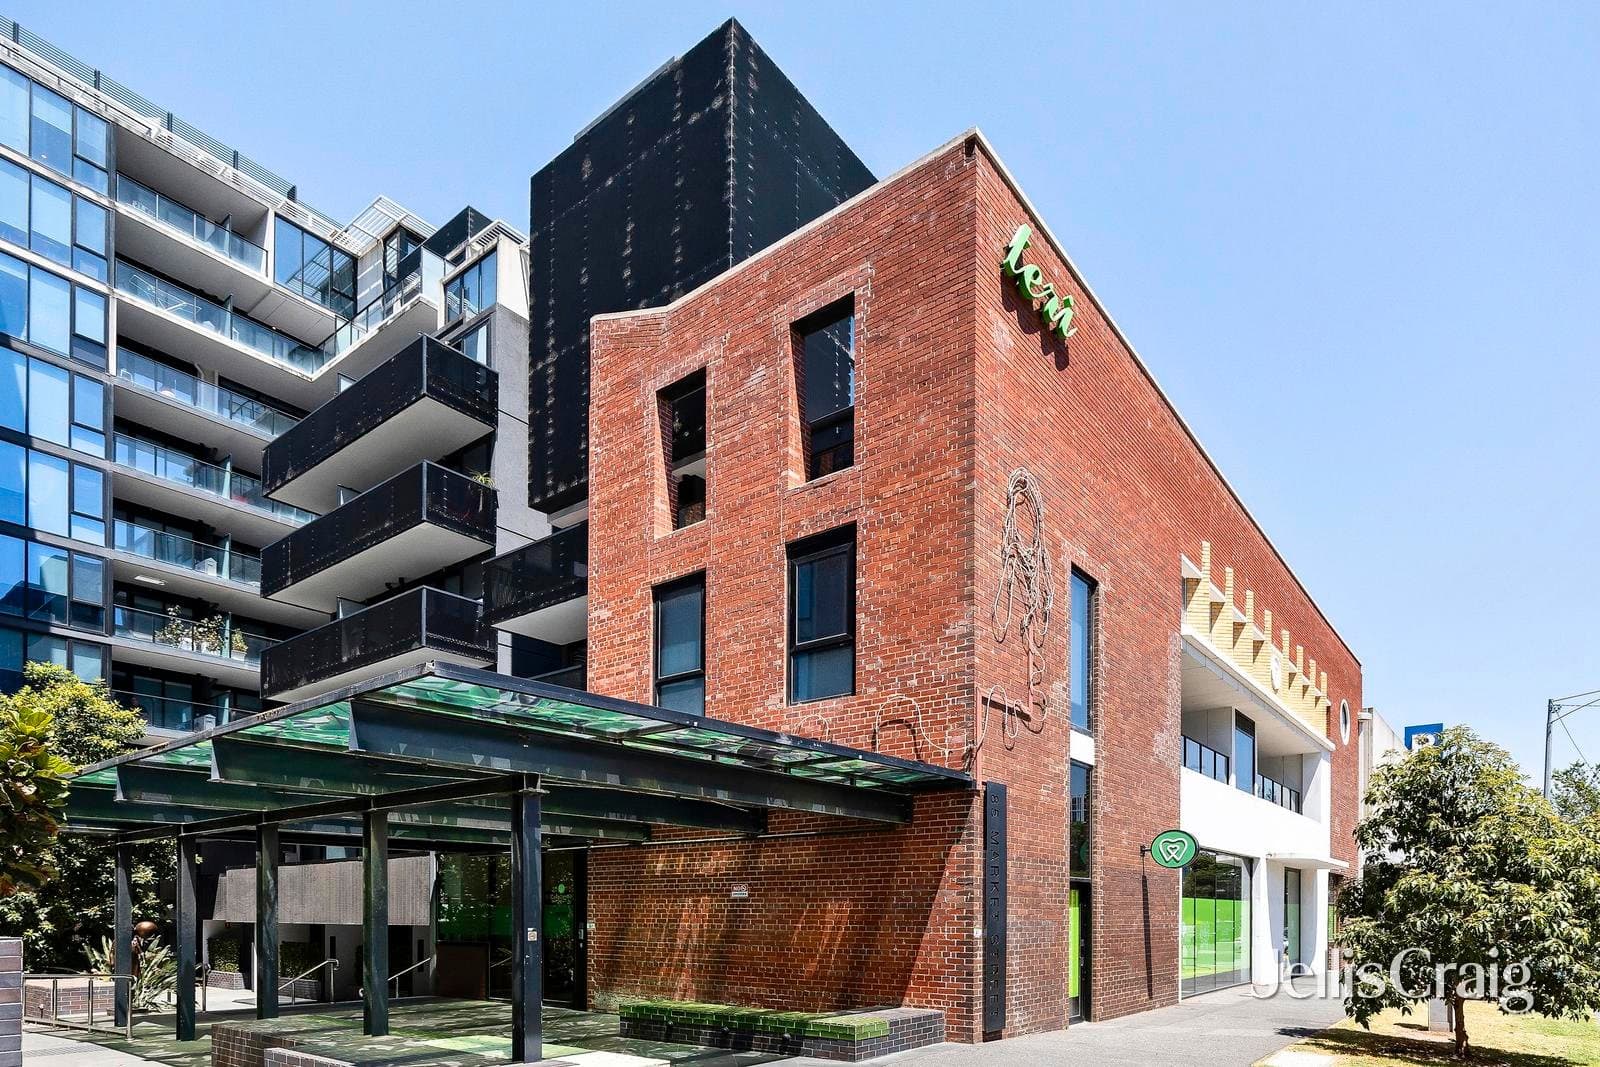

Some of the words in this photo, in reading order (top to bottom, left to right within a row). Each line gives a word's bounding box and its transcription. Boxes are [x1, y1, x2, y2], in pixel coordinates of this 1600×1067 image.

[990, 794, 1000, 817] 85
[990, 830, 1000, 919] MARKET
[989, 934, 1000, 1016] STREET
